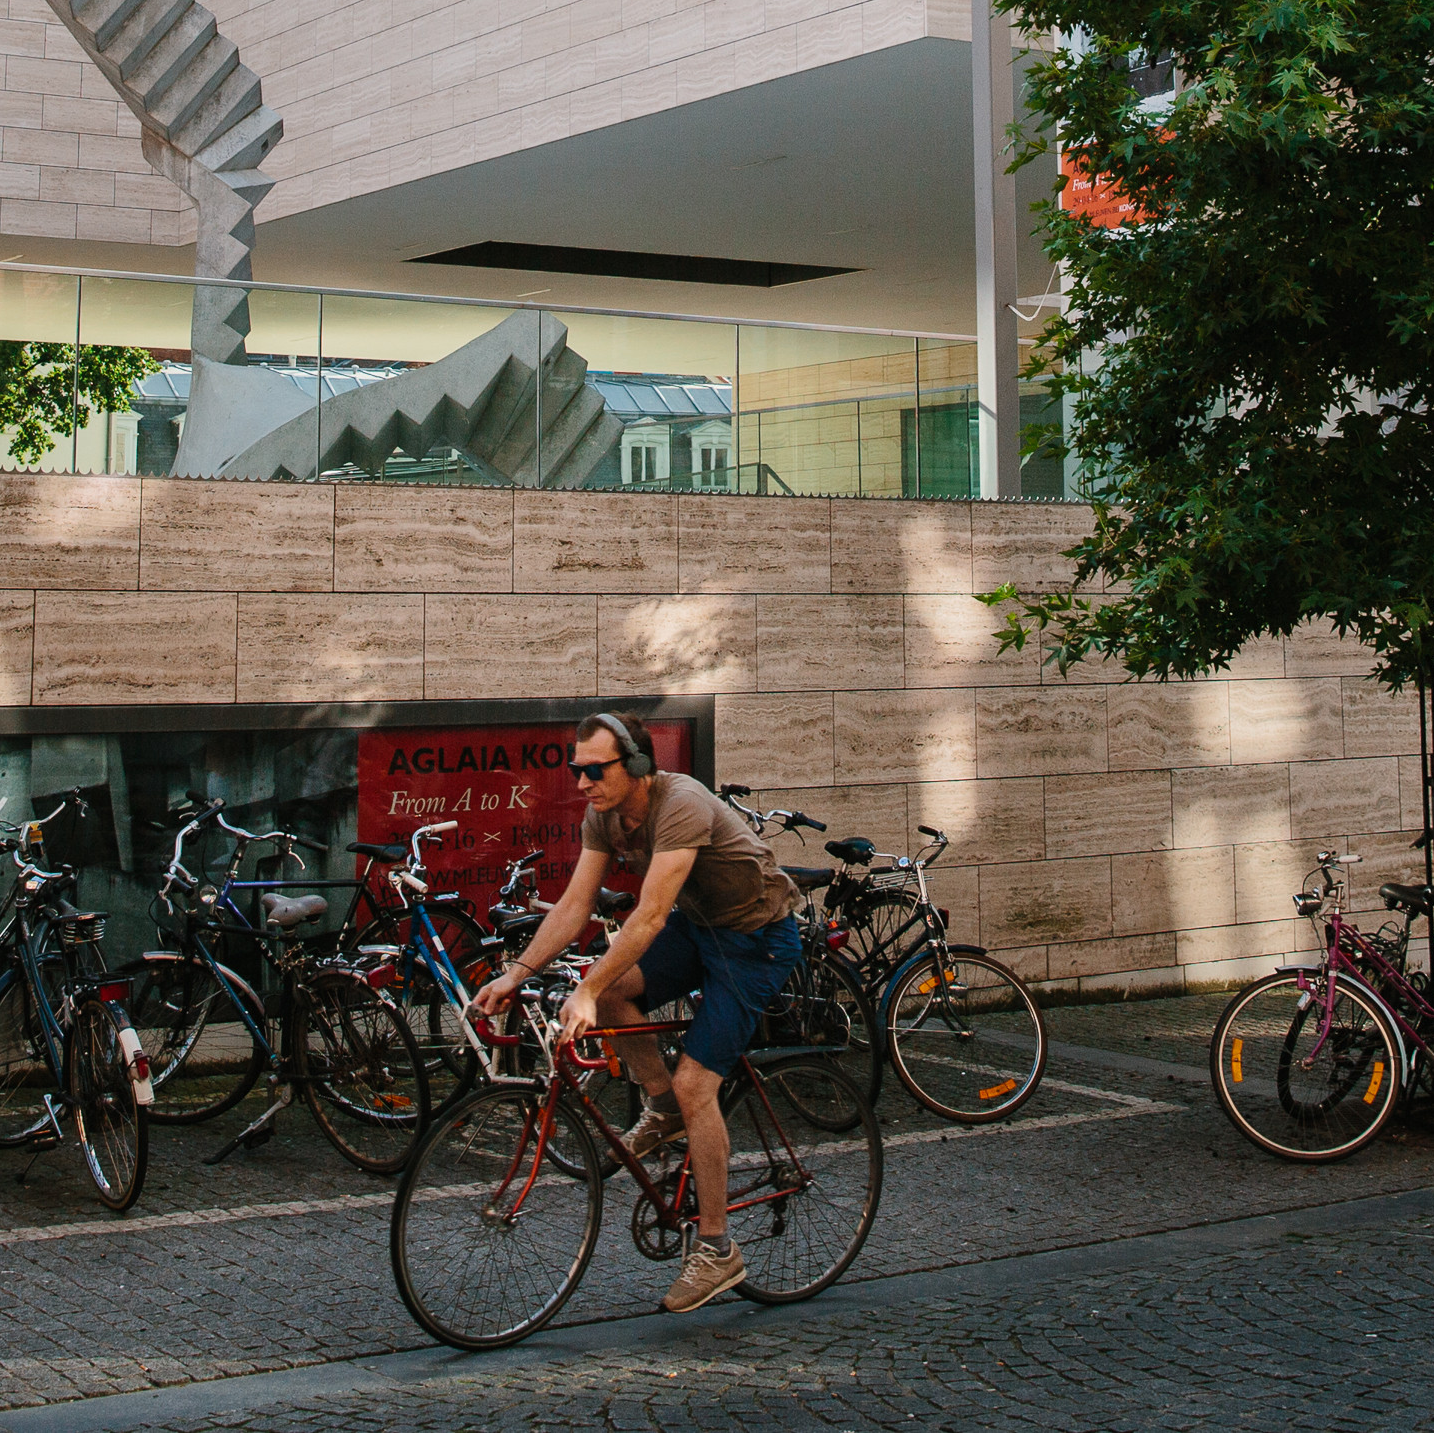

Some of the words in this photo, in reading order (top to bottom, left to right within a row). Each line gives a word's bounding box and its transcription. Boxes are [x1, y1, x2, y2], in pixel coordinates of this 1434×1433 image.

[387, 745, 512, 776] AGLAIA
[387, 790, 447, 815] From
[452, 787, 473, 812] A
[481, 792, 500, 811] to
[506, 784, 531, 809] K
